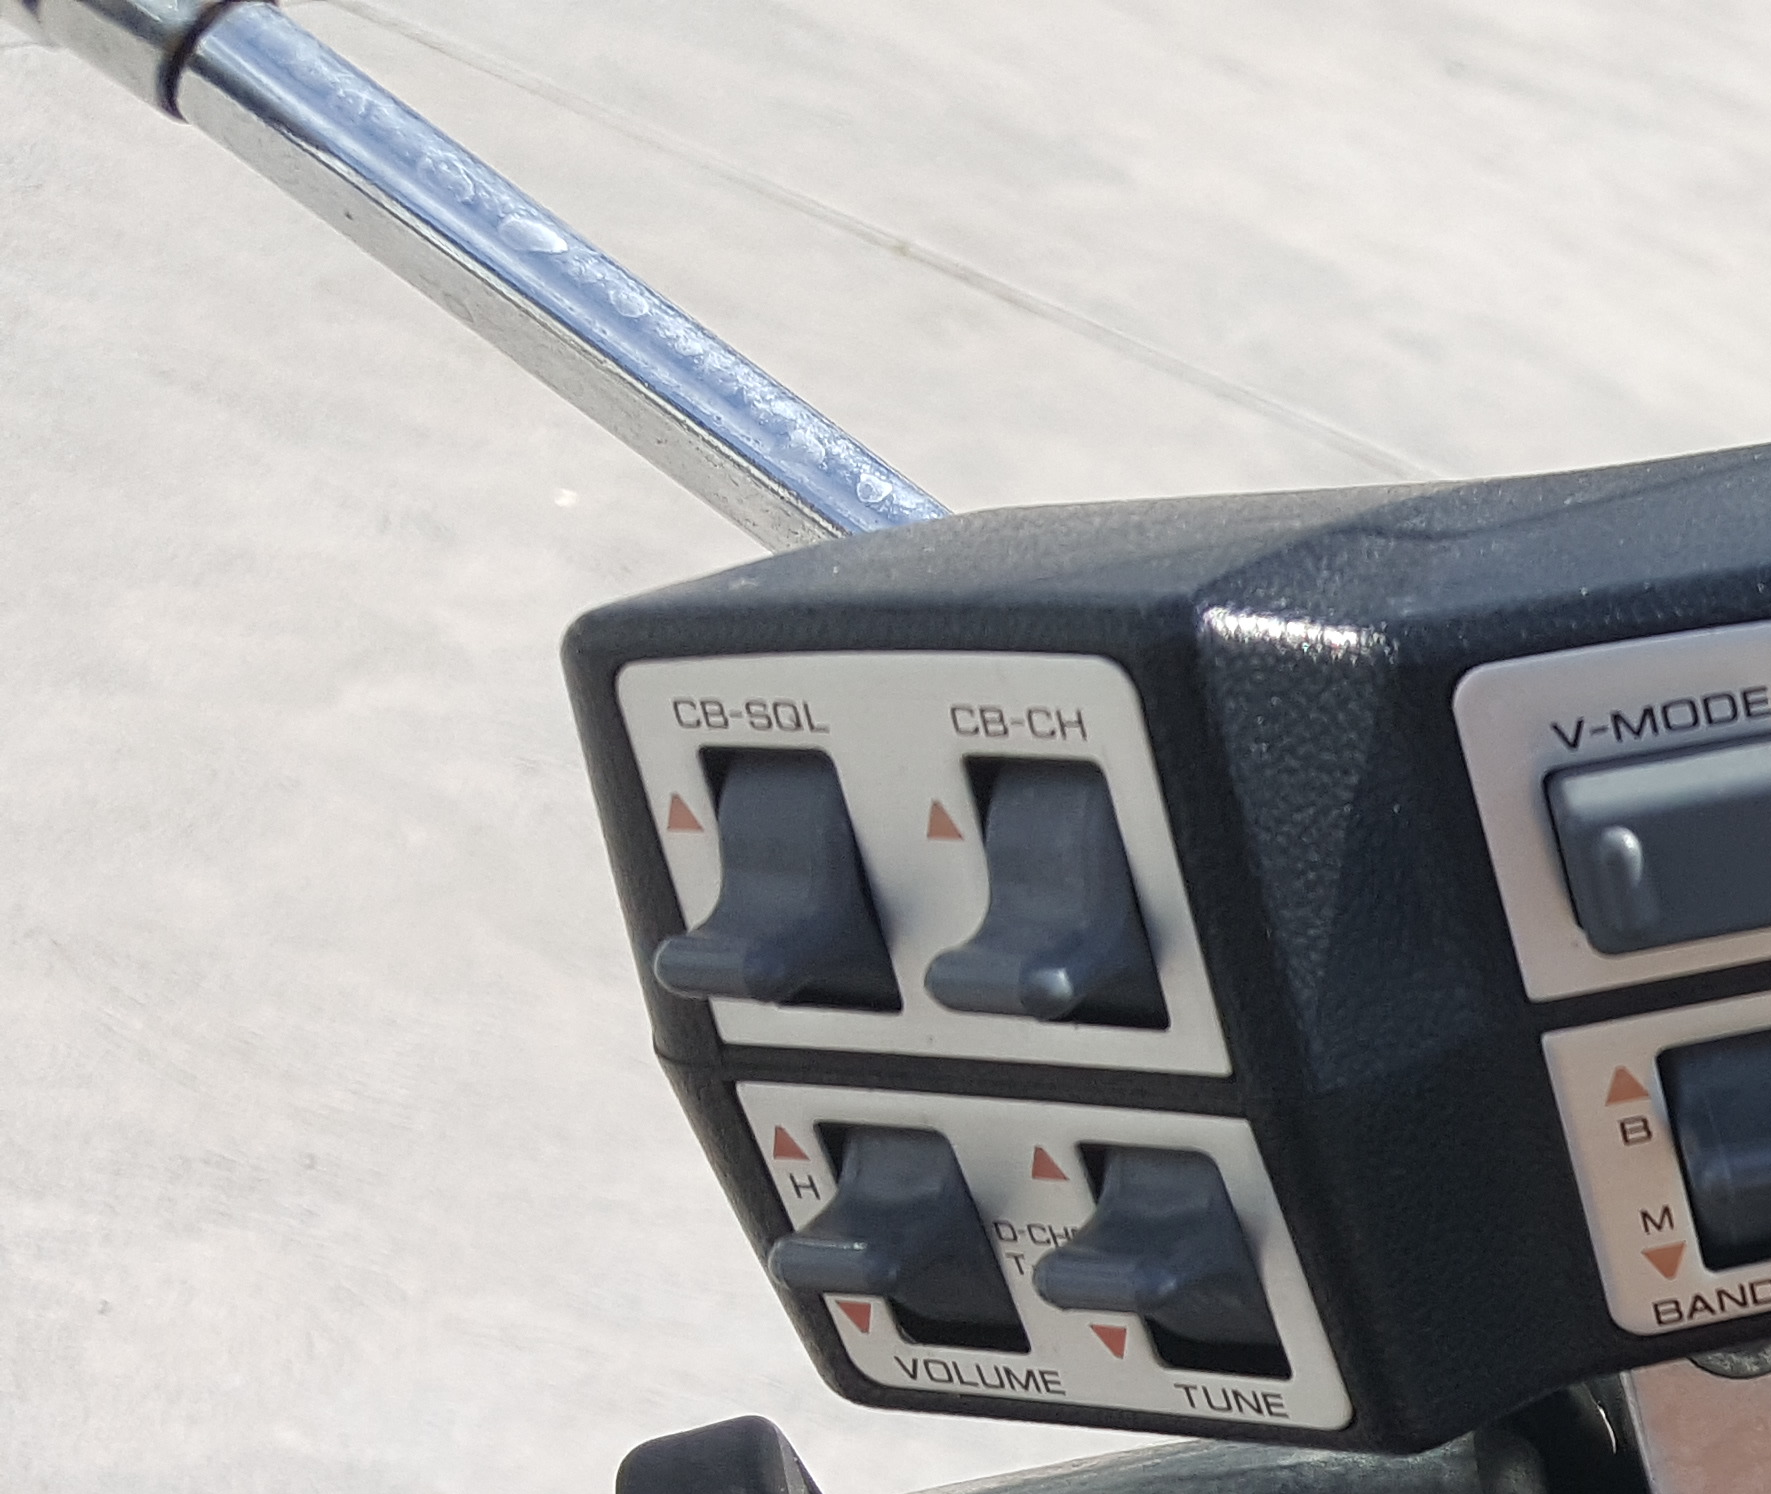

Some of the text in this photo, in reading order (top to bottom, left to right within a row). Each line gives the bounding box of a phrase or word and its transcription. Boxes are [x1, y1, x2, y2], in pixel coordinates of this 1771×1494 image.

[673, 699, 830, 734] CB-SQL
[950, 706, 1088, 741] CB-CH
[1619, 1115, 1653, 1147] B
[1641, 1204, 1675, 1234] M
[893, 1355, 1067, 1397] VOLUME
[1174, 1382, 1290, 1418] TUNE
